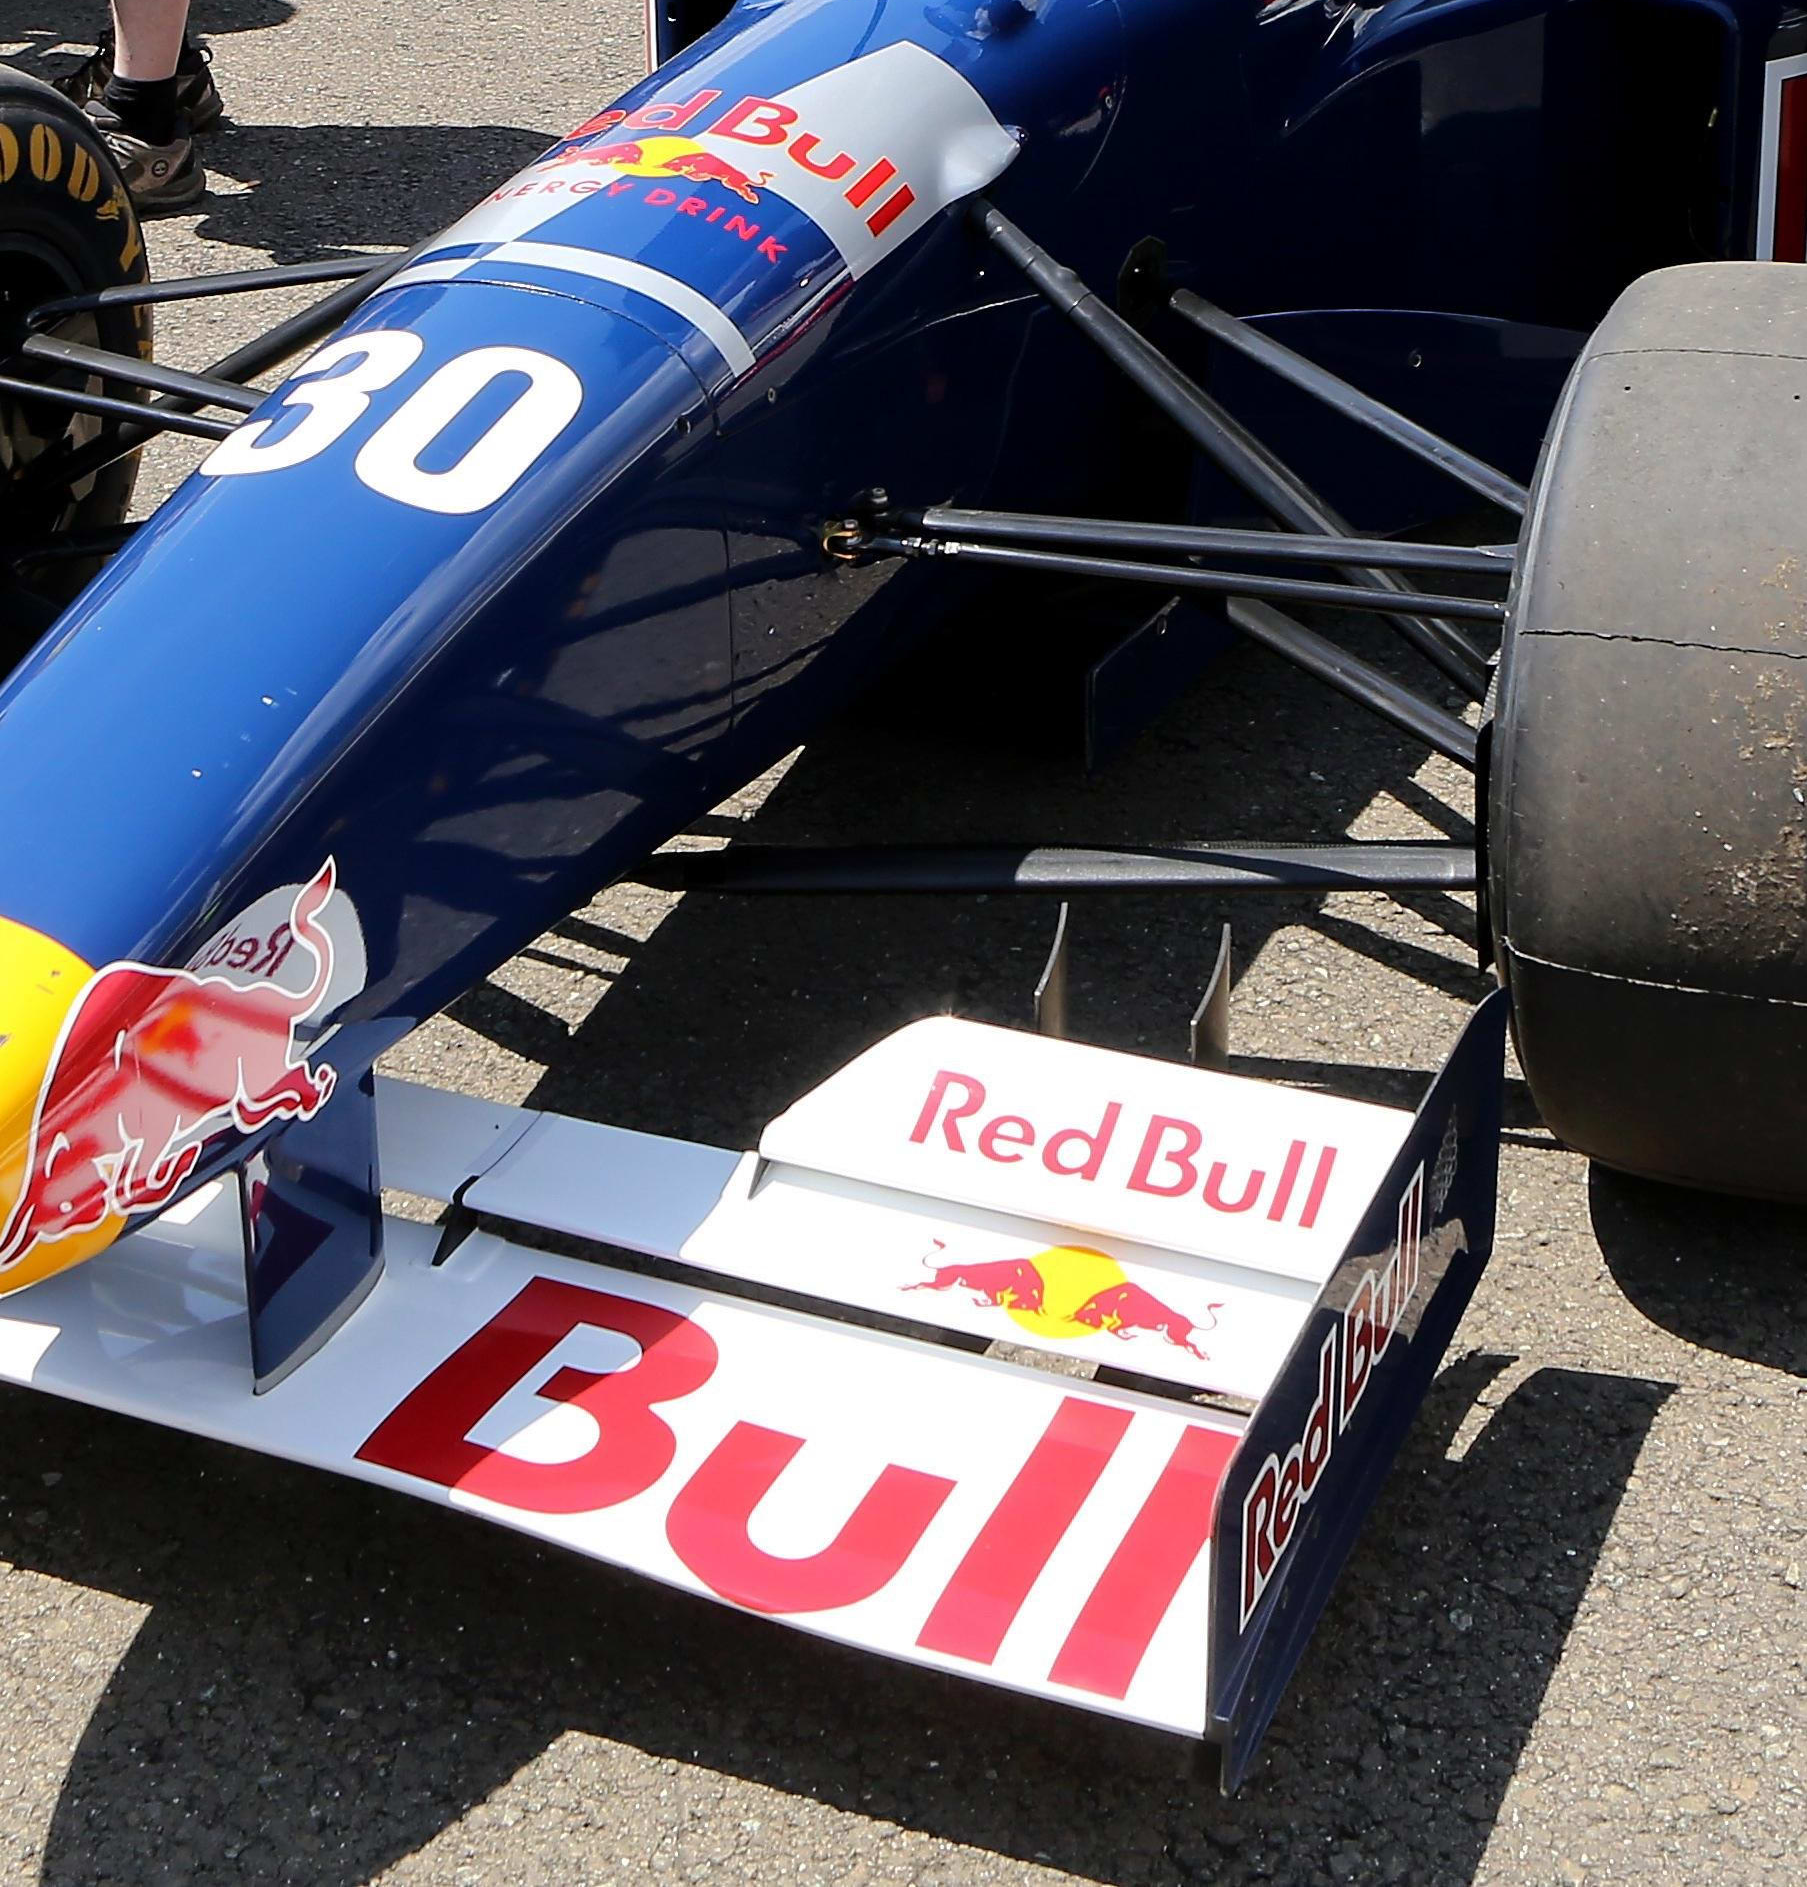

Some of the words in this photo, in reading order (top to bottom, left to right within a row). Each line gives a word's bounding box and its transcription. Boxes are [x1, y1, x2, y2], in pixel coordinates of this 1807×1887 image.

[491, 178, 634, 204] NERGY
[645, 186, 789, 264] DRINK
[564, 89, 724, 142] ed
[708, 95, 917, 238] Bull
[200, 330, 583, 514] 30
[910, 1070, 1122, 1182] Red
[1127, 1113, 1338, 1229] Bull
[1240, 1320, 1338, 1635] Red
[1339, 1159, 1425, 1437] Bull
[355, 1276, 1242, 1700] Bull
